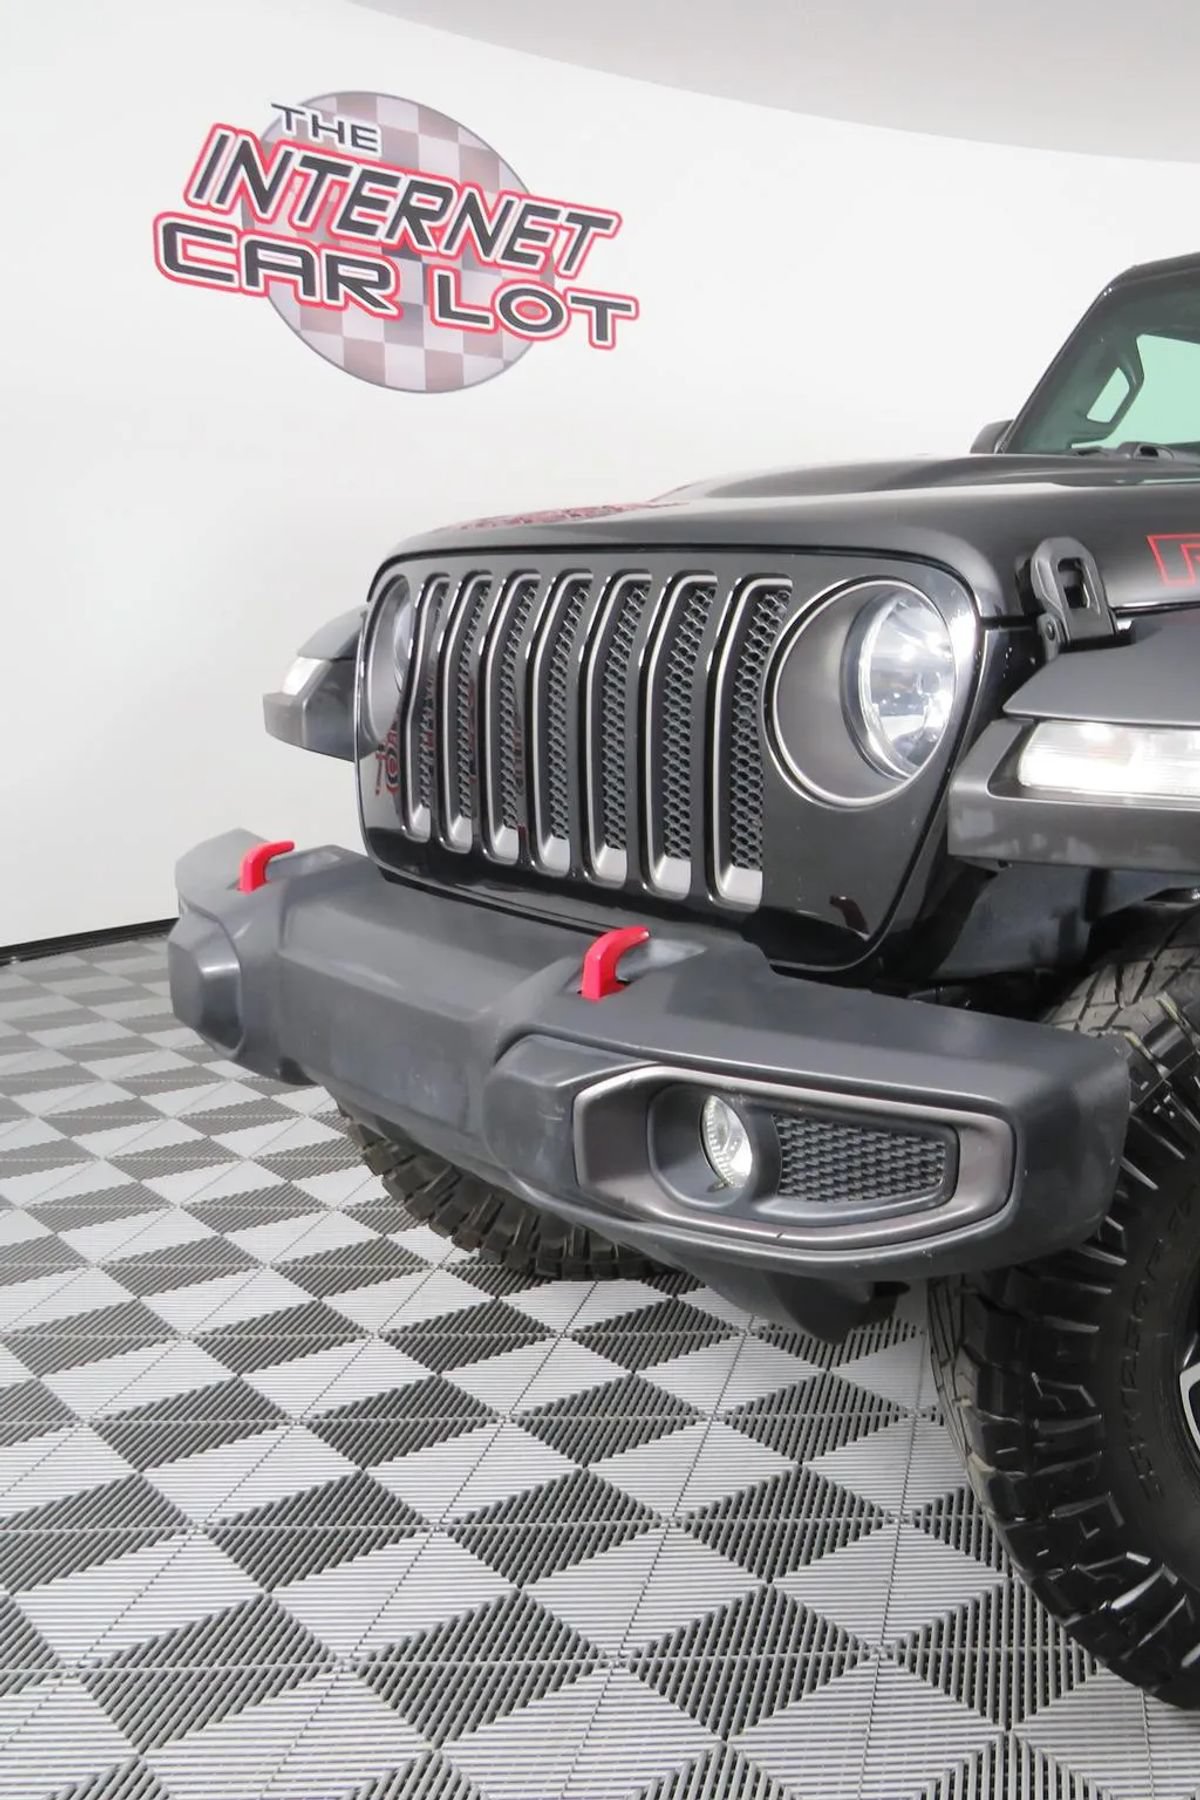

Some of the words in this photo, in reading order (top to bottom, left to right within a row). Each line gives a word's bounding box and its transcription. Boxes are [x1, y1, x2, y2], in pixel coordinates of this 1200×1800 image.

[271, 102, 380, 154] THE
[187, 127, 619, 276] INTERNET
[157, 217, 399, 315] CAR
[433, 269, 636, 346] LOT
